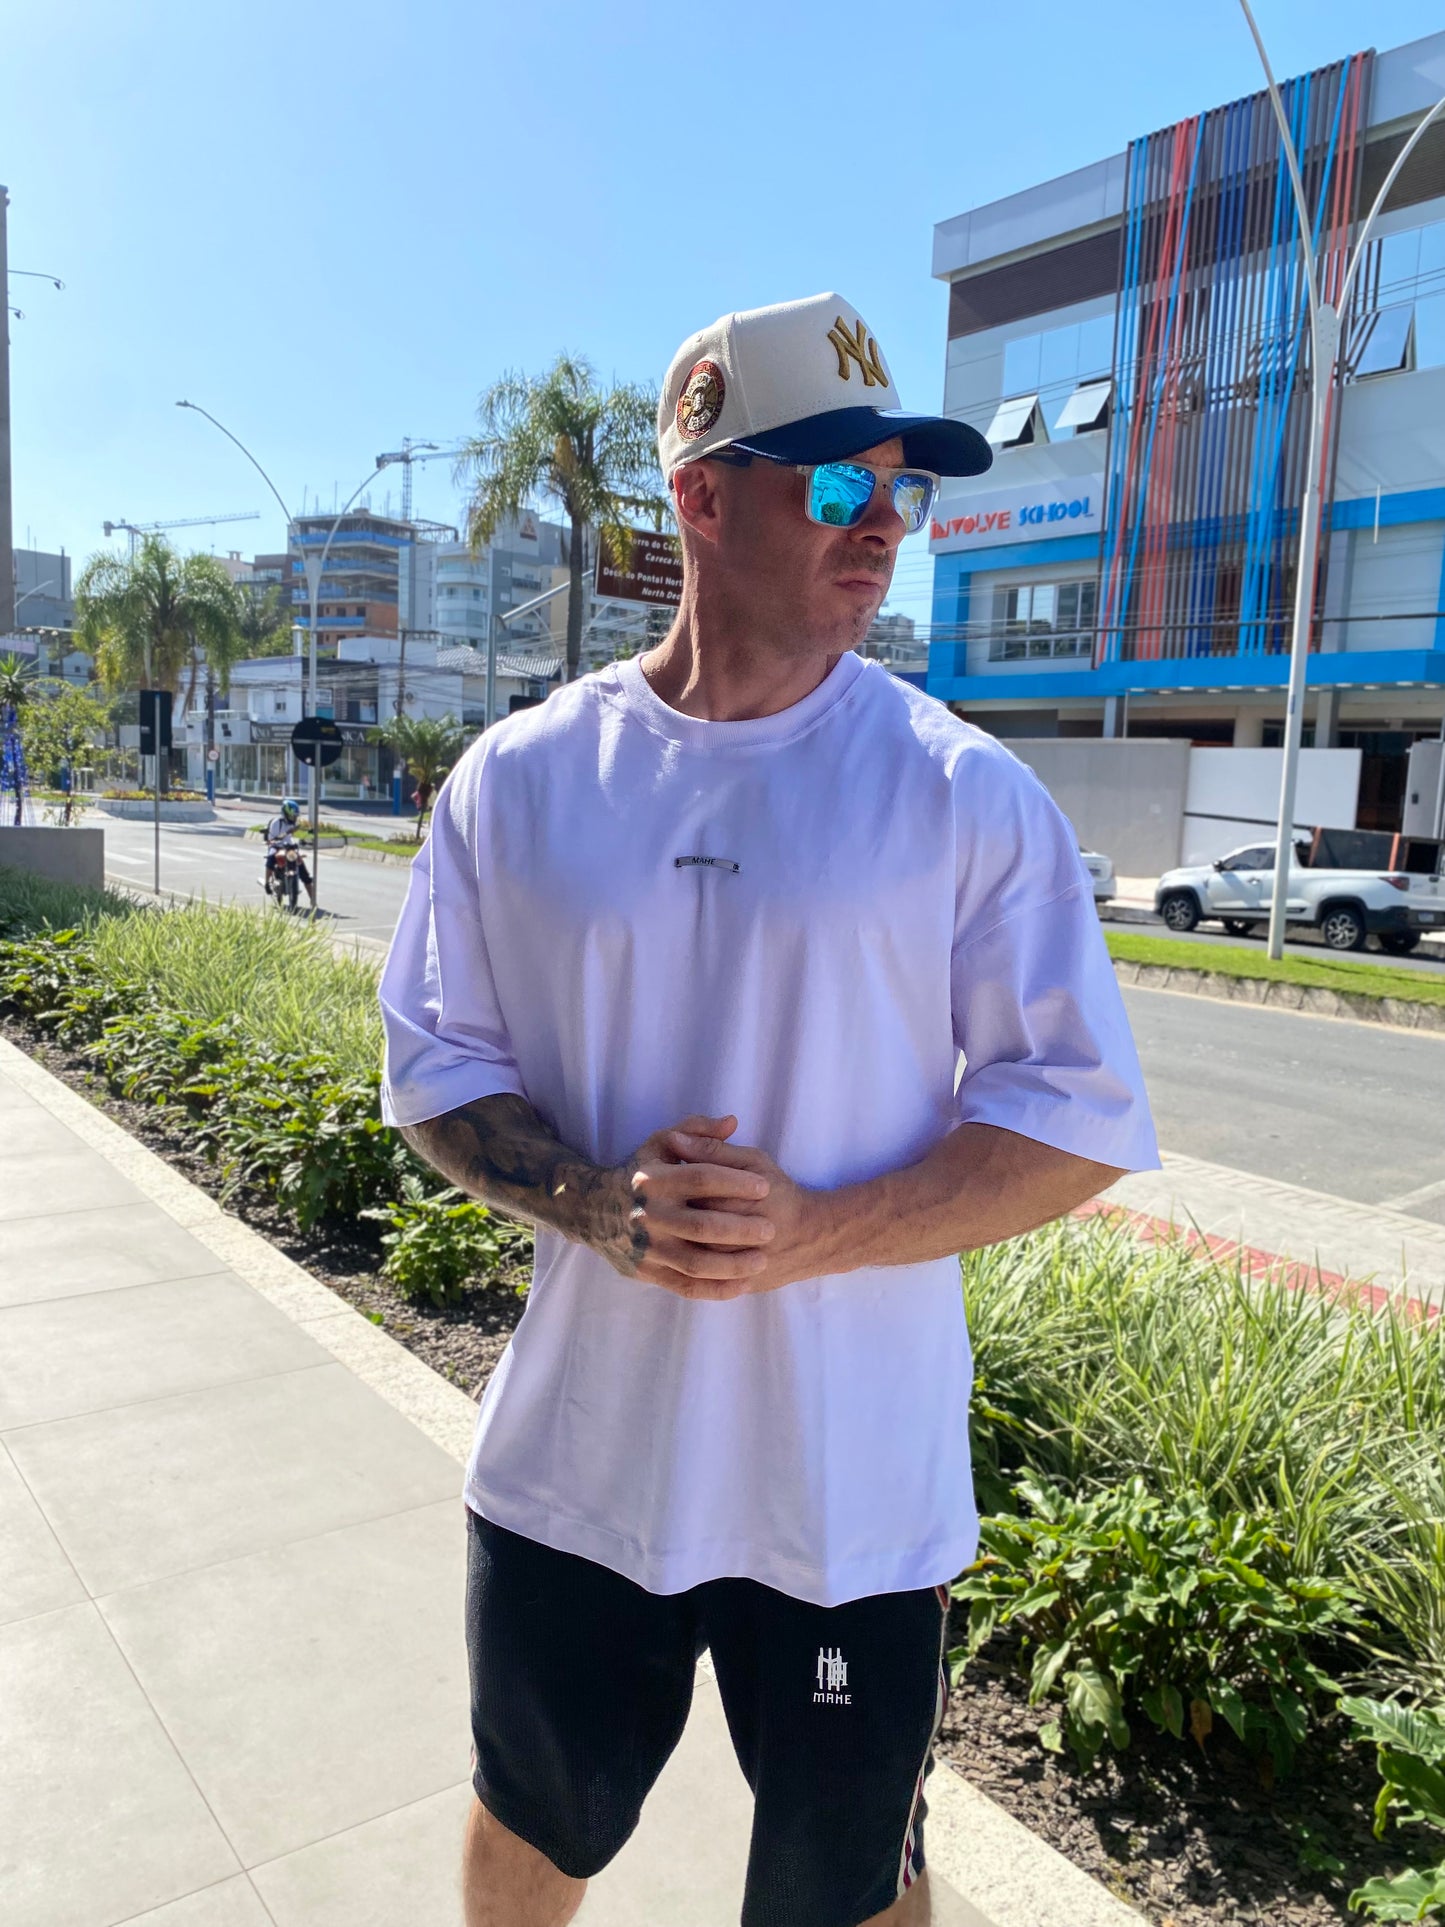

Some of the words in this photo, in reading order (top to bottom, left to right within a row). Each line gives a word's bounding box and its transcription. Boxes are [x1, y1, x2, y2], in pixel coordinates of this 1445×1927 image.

[827, 315, 889, 388] NY
[1018, 496, 1094, 526] SCHOOL
[651, 541, 661, 549] do
[626, 571, 635, 579] do
[637, 572, 663, 584] Pontal
[665, 577, 682, 587] Nort
[642, 587, 664, 598] North
[667, 591, 682, 600] Dec
[813, 1692, 852, 1705] MAHE
